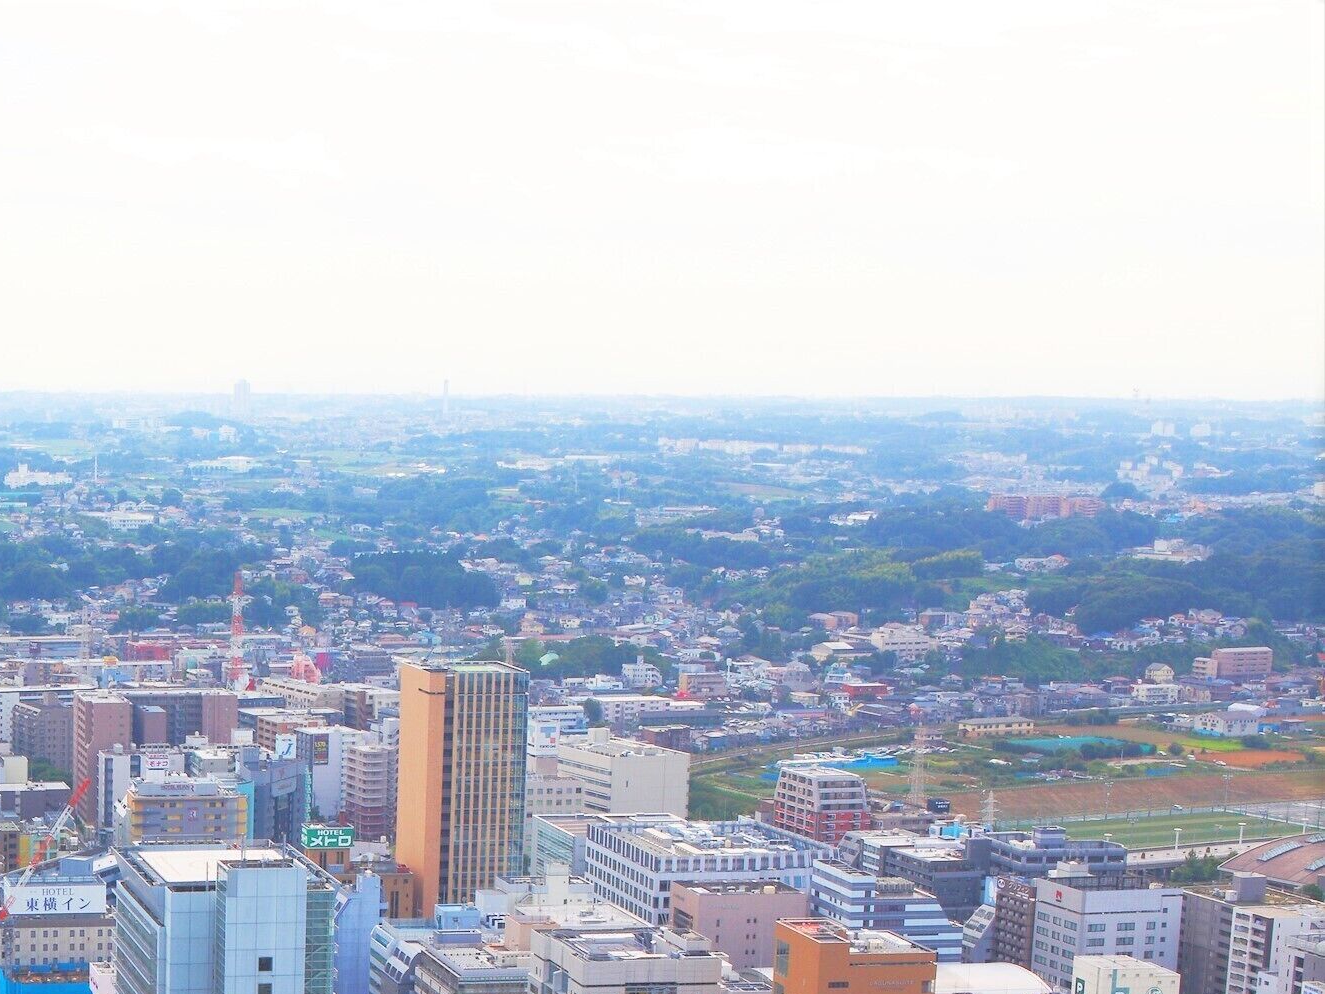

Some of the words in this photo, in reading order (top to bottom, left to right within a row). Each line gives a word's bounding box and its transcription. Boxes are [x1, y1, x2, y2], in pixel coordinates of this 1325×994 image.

[310, 836, 353, 848] メトロ
[42, 887, 75, 896] HOTEL
[26, 896, 92, 912] 東横イン
